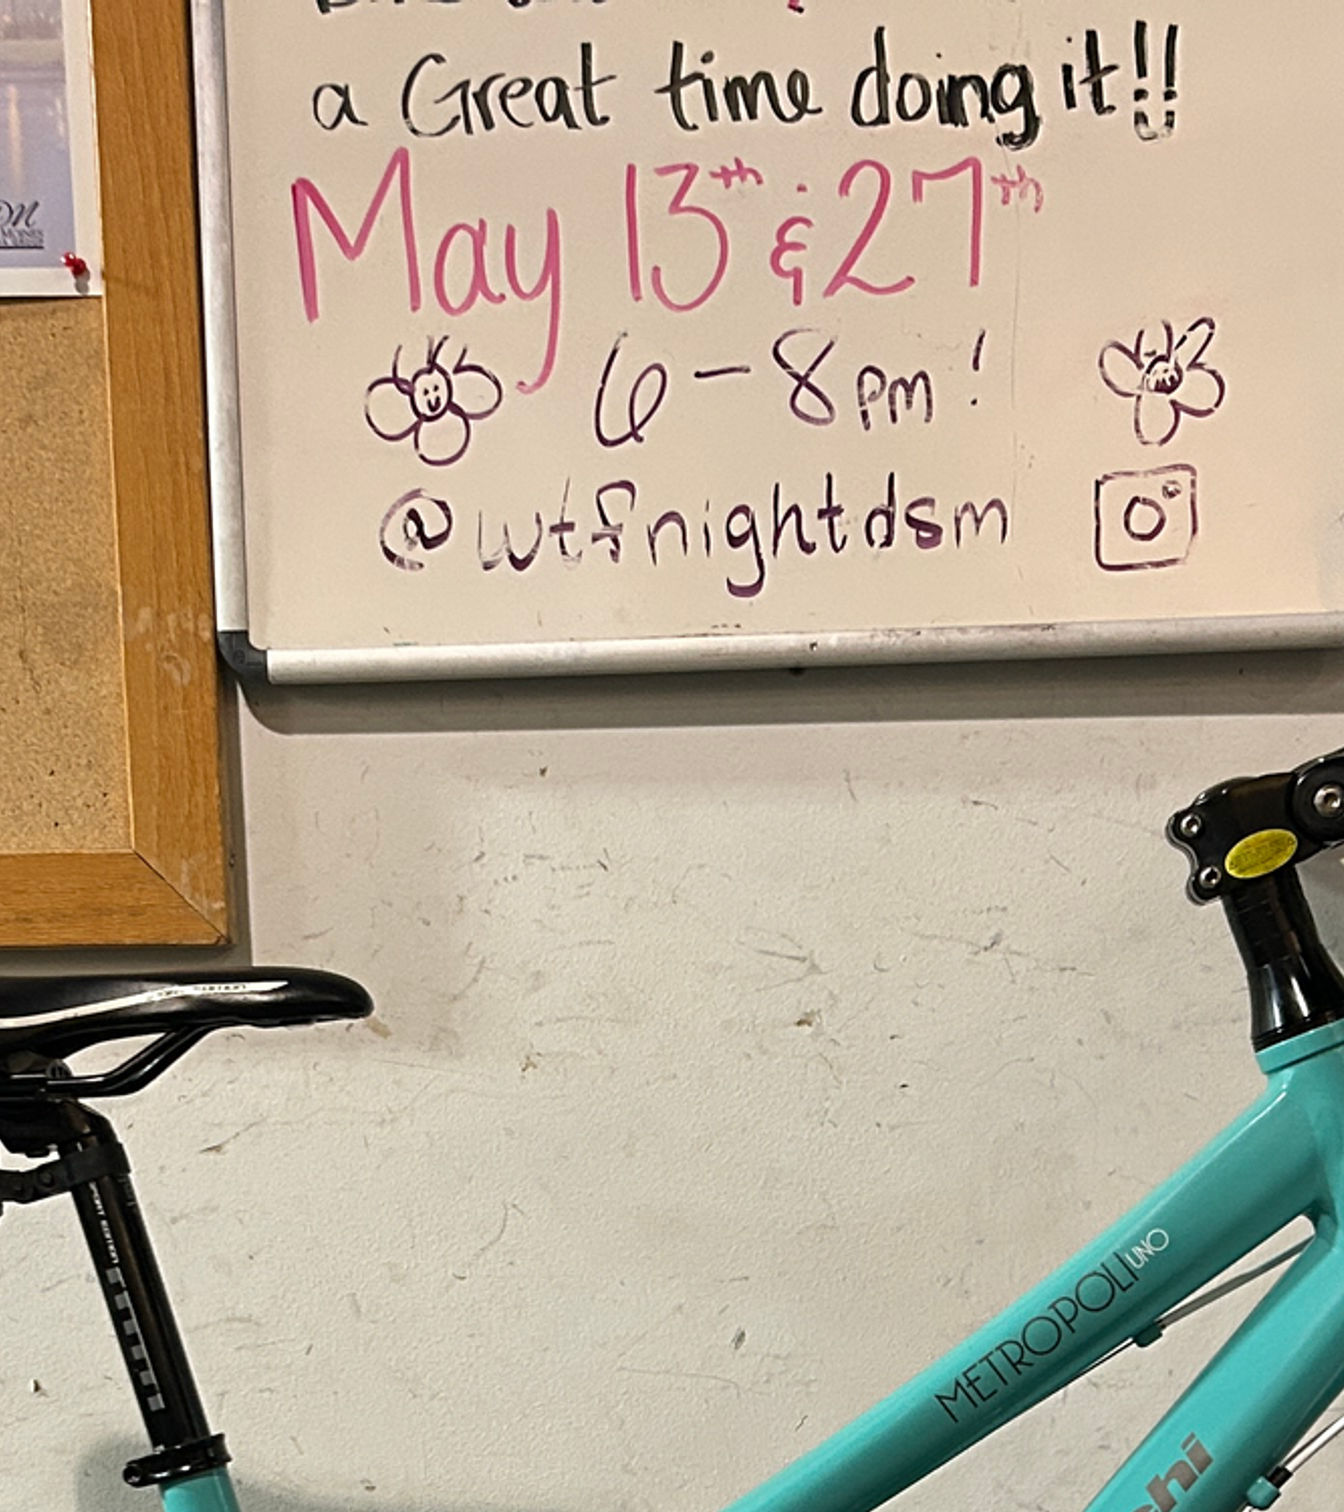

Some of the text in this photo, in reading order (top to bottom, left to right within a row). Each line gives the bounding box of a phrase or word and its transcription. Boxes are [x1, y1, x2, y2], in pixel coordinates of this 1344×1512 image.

[312, 74, 367, 131] a
[400, 41, 616, 138] Great
[656, 37, 819, 124] time
[854, 26, 1042, 148] doing
[290, 147, 562, 395] May
[624, 158, 764, 313] 13th
[824, 157, 1044, 296] 27th
[934, 1228, 1170, 1423] METROPOLI UNO
